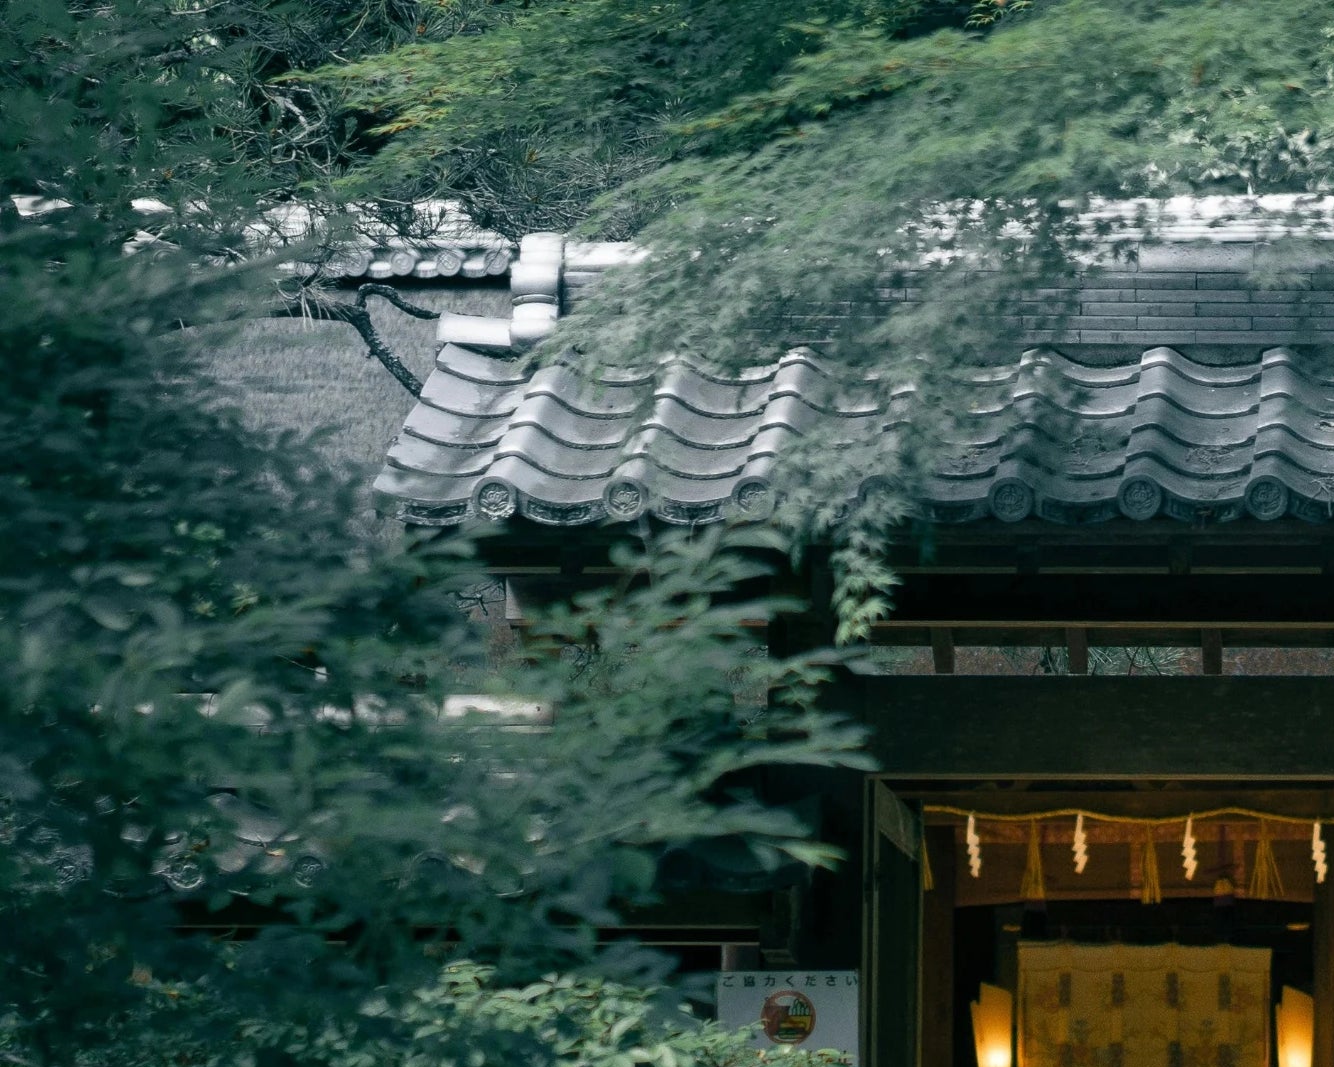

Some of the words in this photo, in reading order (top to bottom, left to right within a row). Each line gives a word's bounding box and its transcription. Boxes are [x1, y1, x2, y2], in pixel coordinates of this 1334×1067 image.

[722, 976, 858, 987] ご協力ください
